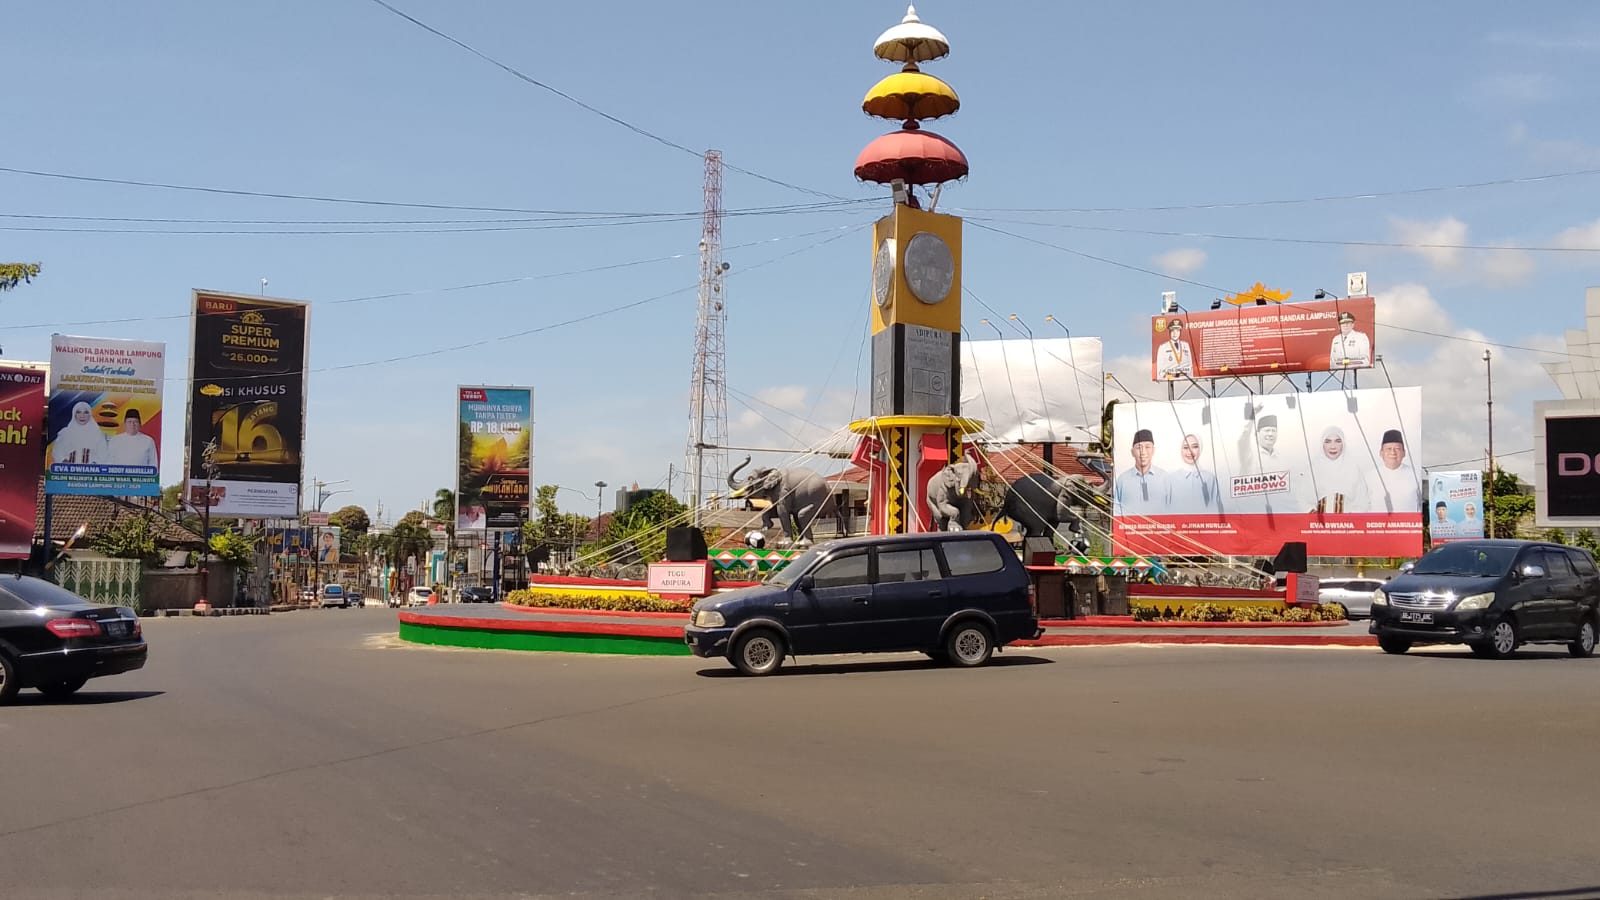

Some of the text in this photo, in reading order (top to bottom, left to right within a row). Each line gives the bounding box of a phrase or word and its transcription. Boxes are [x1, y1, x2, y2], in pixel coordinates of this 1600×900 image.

[205, 301, 233, 311] BARU
[1185, 319, 1215, 329] PROGRAM
[1248, 315, 1279, 325] WALIKOTA
[1306, 311, 1337, 321] LAMPUNG
[231, 324, 272, 337] SUPER
[222, 334, 279, 348] PREMIUM
[55, 345, 162, 358] WALIKOTA BANDAR LAMPUNG
[230, 352, 268, 363] 26.000
[23, 375, 41, 384] DKI
[238, 384, 287, 396] KHUSUS
[470, 421, 483, 433] RP
[1233, 474, 1277, 485] PILIHAN
[1233, 480, 1287, 492] PRABOWO
[661, 579, 692, 587] ADIPURA
